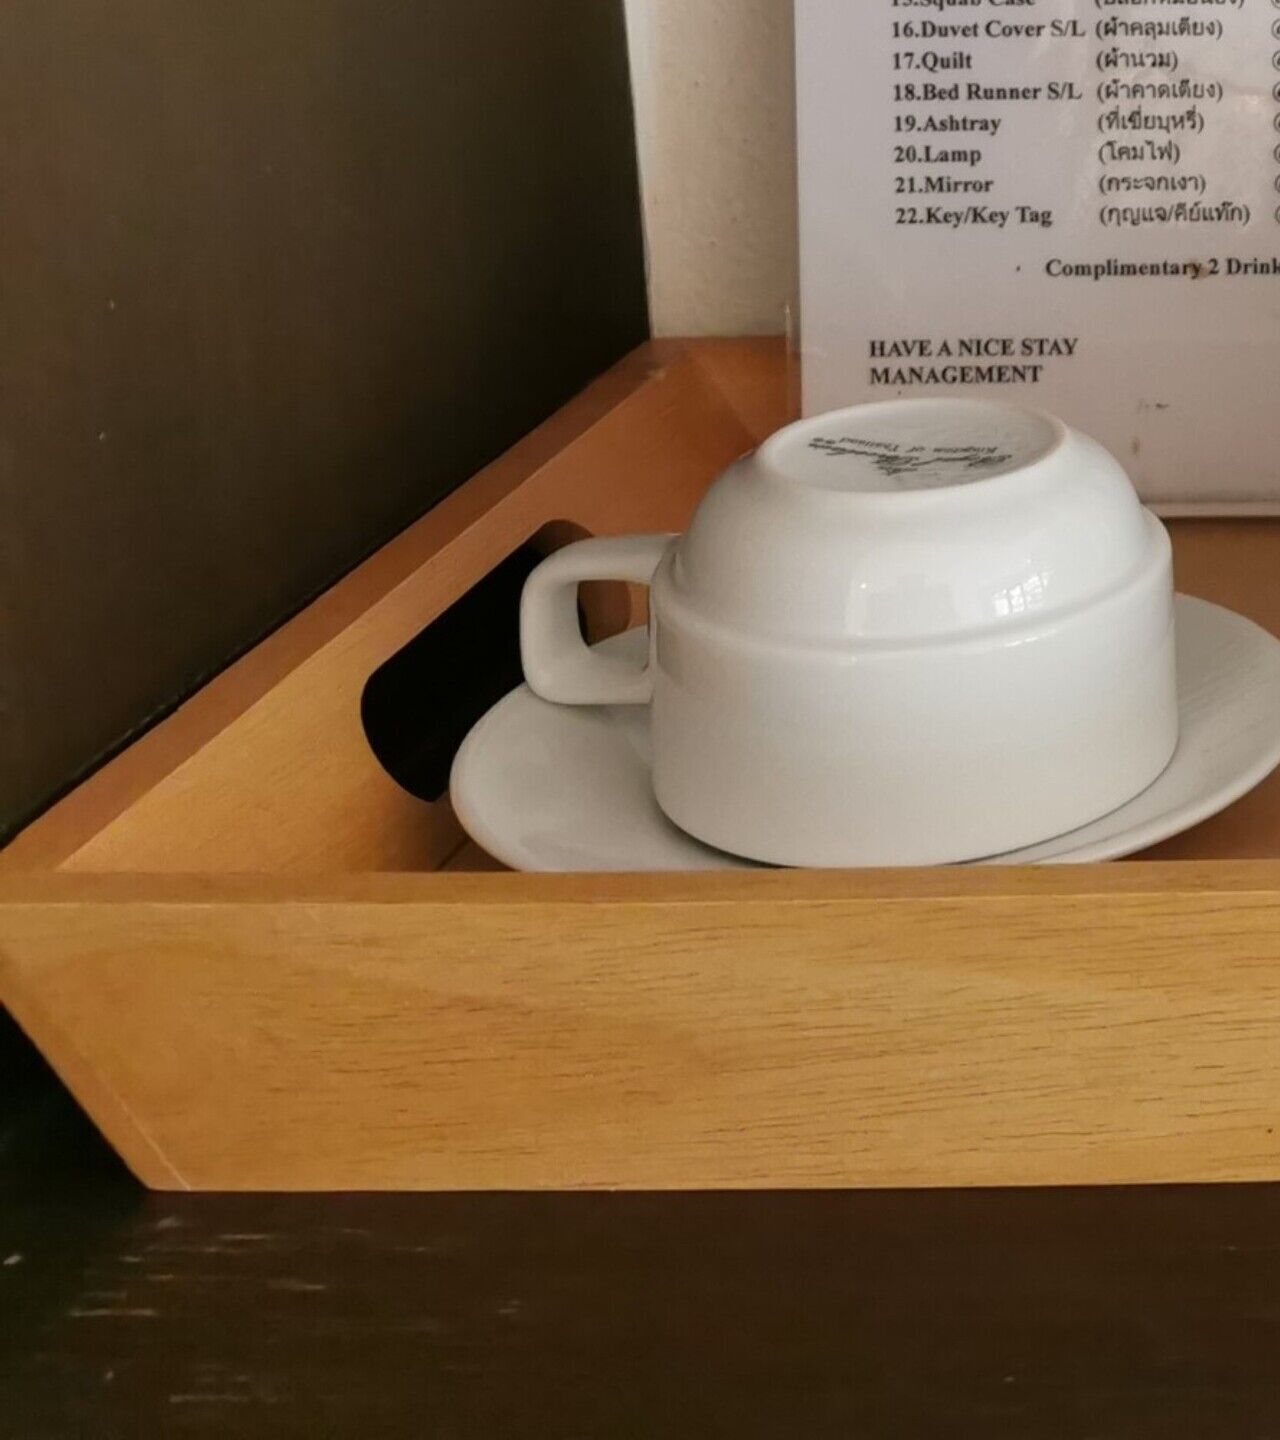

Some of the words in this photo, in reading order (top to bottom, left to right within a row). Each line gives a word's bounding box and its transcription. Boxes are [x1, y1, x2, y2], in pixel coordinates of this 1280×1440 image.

[893, 21, 979, 38] 16.Duvet
[985, 20, 1046, 38] Cover
[1050, 19, 1086, 37] S/L
[893, 51, 972, 73] 17.Quilt
[894, 83, 959, 102] 18.Bed
[966, 83, 1042, 100] Runner
[1047, 82, 1082, 100] S/L
[895, 115, 1001, 136] 19.Ashtray
[894, 145, 982, 167] 20.Lamp
[895, 176, 994, 194] 21.Mirror
[896, 206, 1009, 228] 22.Key/Key
[1015, 206, 1053, 228] Tag
[1045, 259, 1201, 282] Complimentary
[1208, 258, 1220, 275] 2
[870, 339, 932, 358] HAVE
[937, 340, 952, 356] A
[958, 338, 1015, 356] NICE
[1021, 338, 1078, 356] STAY
[870, 365, 1043, 385] MANAGEMENT
